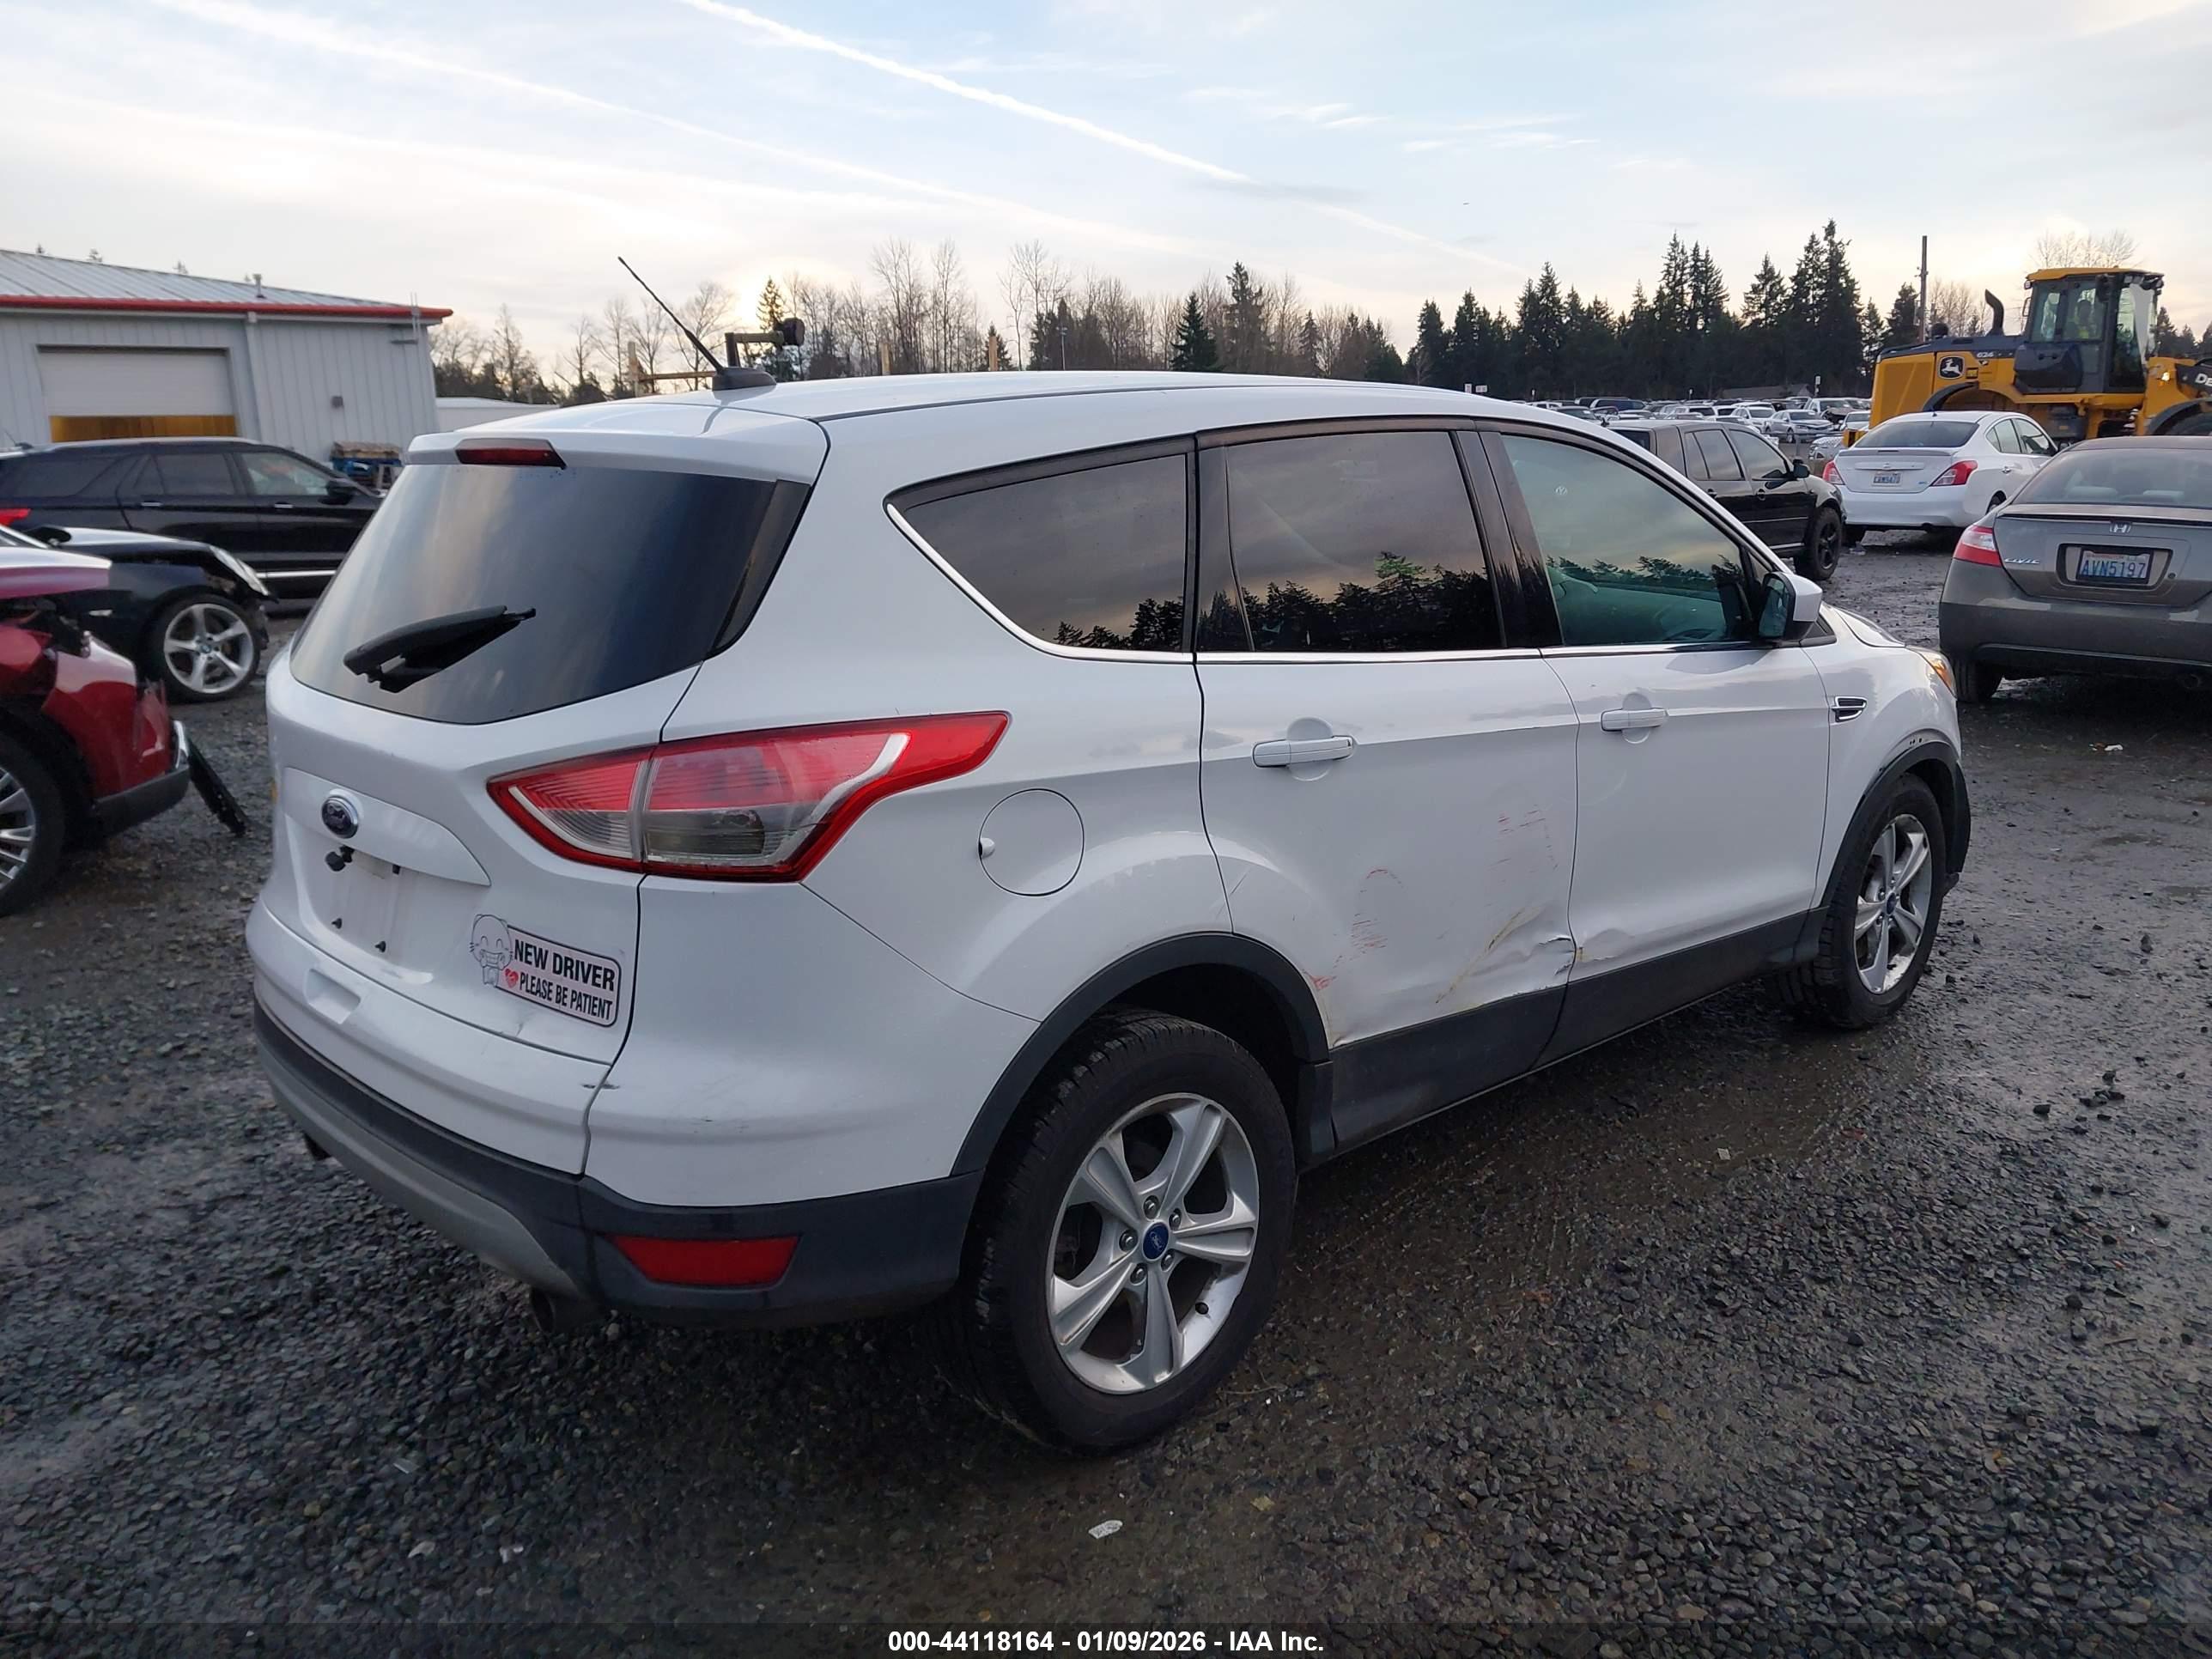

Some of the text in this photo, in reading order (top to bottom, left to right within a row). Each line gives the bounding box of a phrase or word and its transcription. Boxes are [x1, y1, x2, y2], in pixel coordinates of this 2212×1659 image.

[2081, 559, 2147, 579] AVN5197
[514, 939, 616, 992] NEW DRIVER
[520, 971, 613, 1020] PLEASE BE PATIENT
